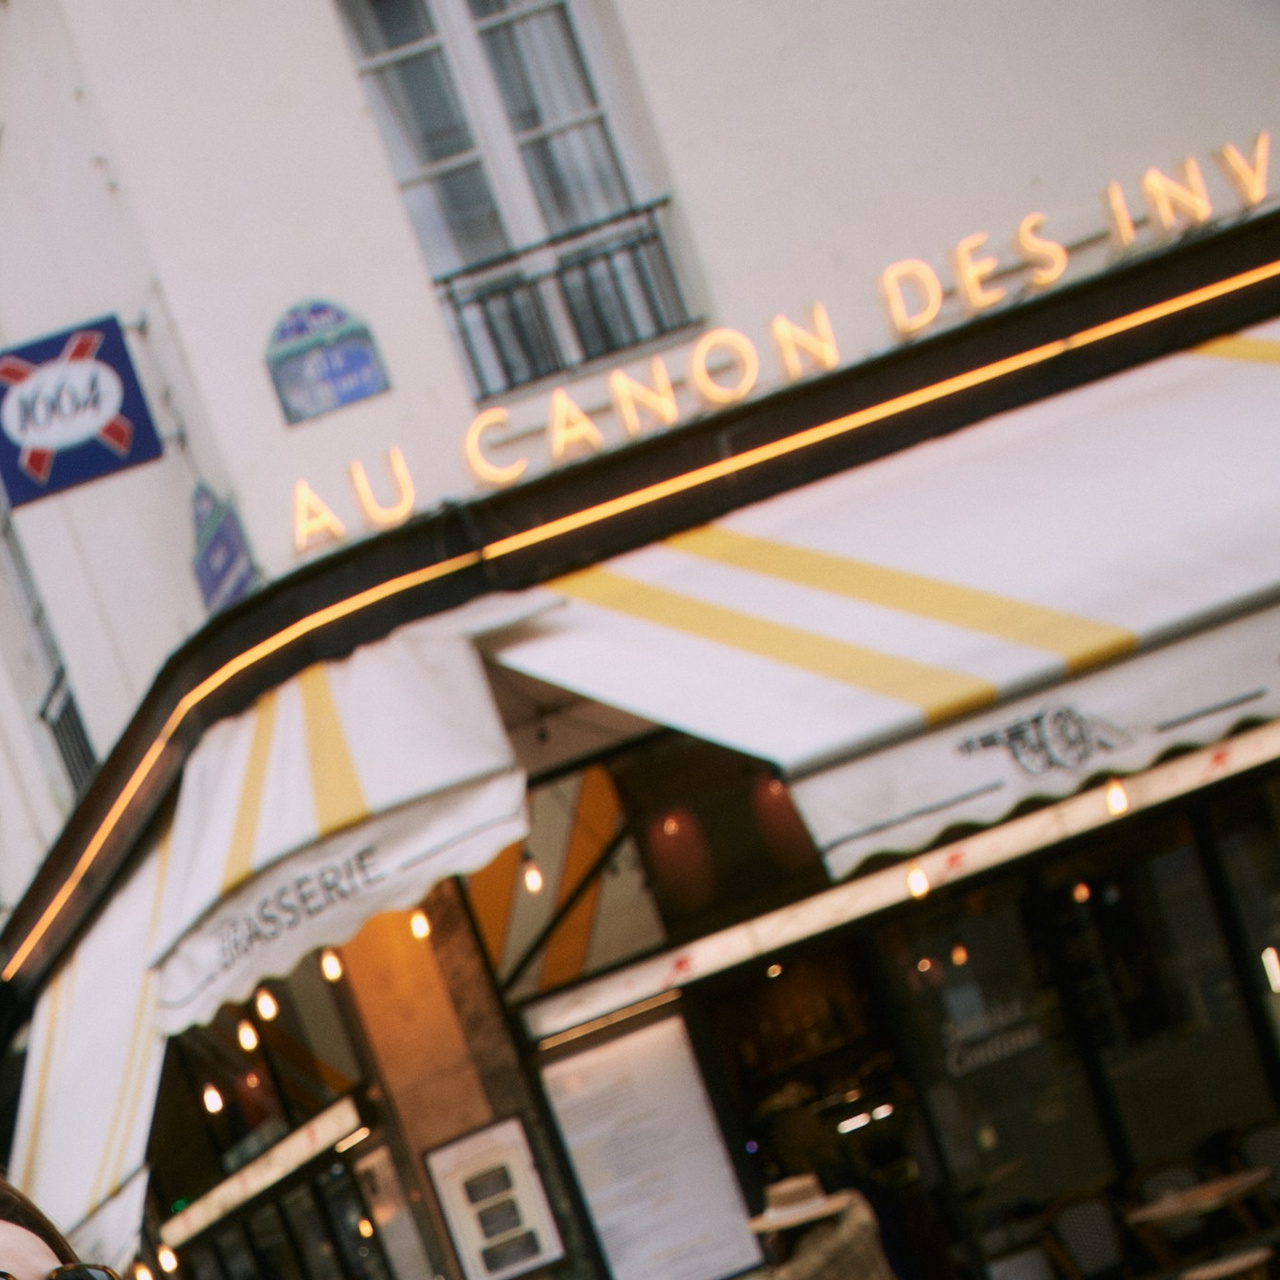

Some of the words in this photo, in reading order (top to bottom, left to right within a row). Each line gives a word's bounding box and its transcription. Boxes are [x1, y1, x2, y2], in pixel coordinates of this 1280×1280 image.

[292, 445, 415, 552] AU
[465, 302, 840, 484] CANON
[881, 211, 1068, 334] DES
[1106, 128, 1271, 247] INV
[220, 845, 387, 969] BRASSERIE
